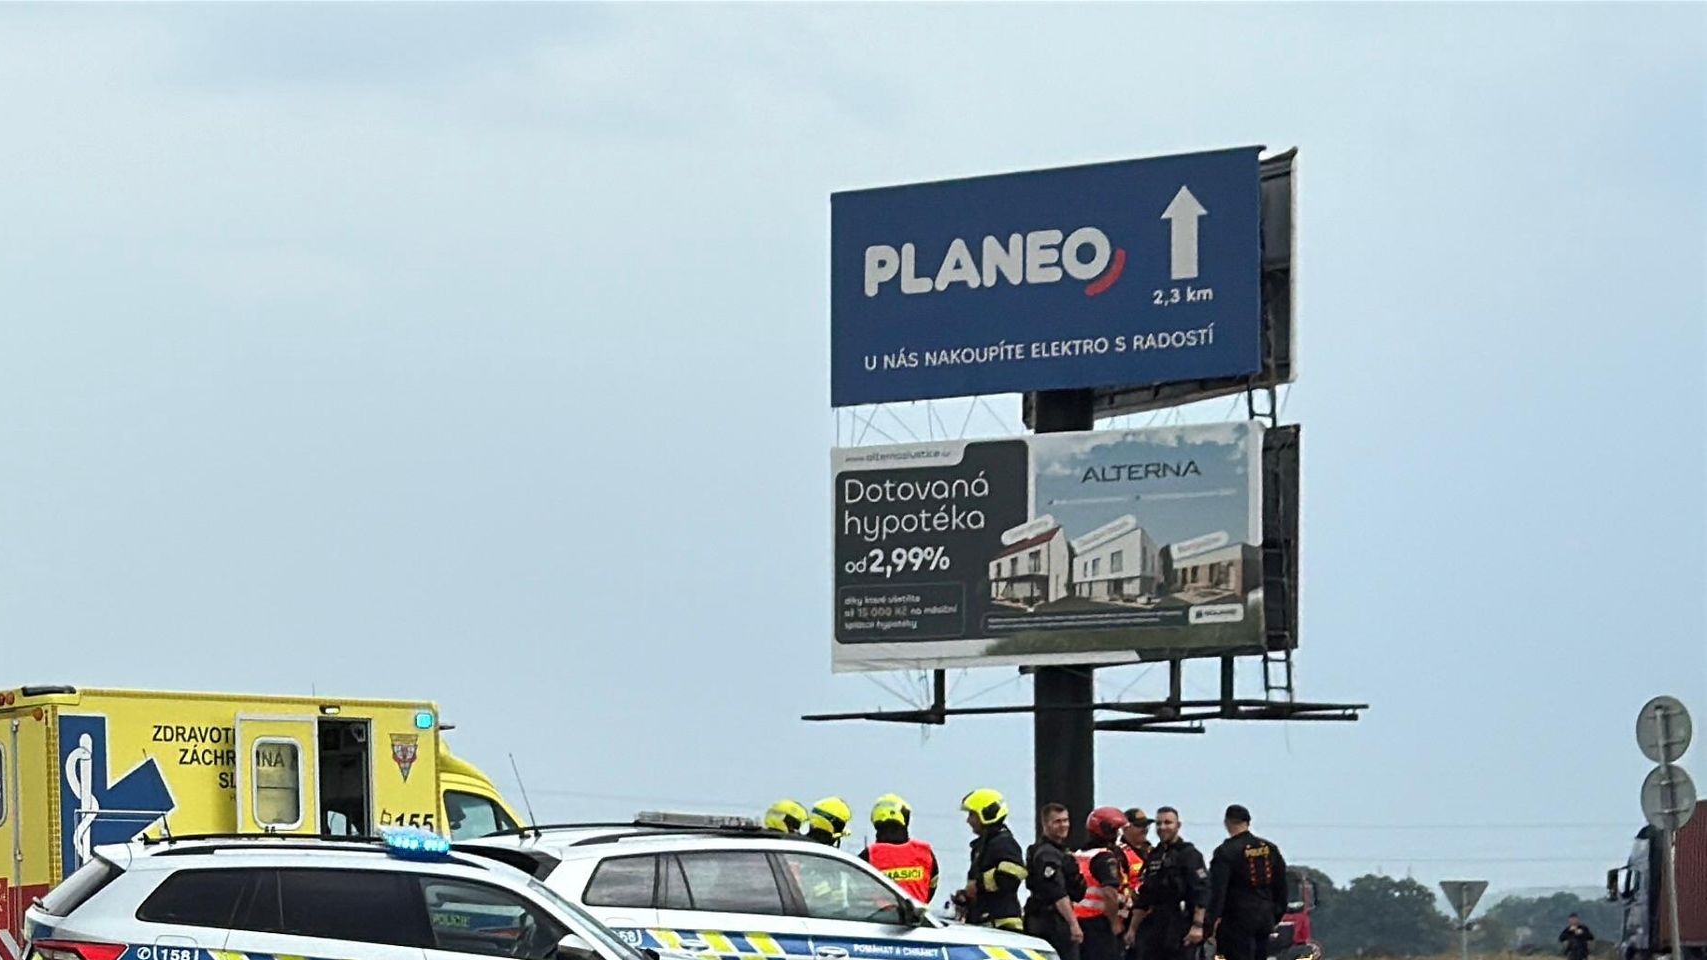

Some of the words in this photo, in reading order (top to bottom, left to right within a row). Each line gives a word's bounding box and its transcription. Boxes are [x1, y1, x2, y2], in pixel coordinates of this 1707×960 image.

[864, 227, 1112, 297] PLANEO
[1153, 289, 1180, 307] 2,3
[1185, 287, 1214, 303] km
[864, 355, 878, 371] U
[883, 347, 919, 370] NÁS
[924, 340, 1025, 367] NAKOUPÍTE
[1031, 336, 1109, 359] ELEKTRO
[1114, 335, 1127, 352] S
[1132, 322, 1216, 351] RADOSTÍ
[845, 470, 990, 504] Dotovaná
[1081, 460, 1202, 484] ALTERNA
[844, 504, 986, 542] hypotéka
[844, 557, 867, 574] od
[868, 546, 951, 579] 2,99%
[395, 812, 435, 833] 155
